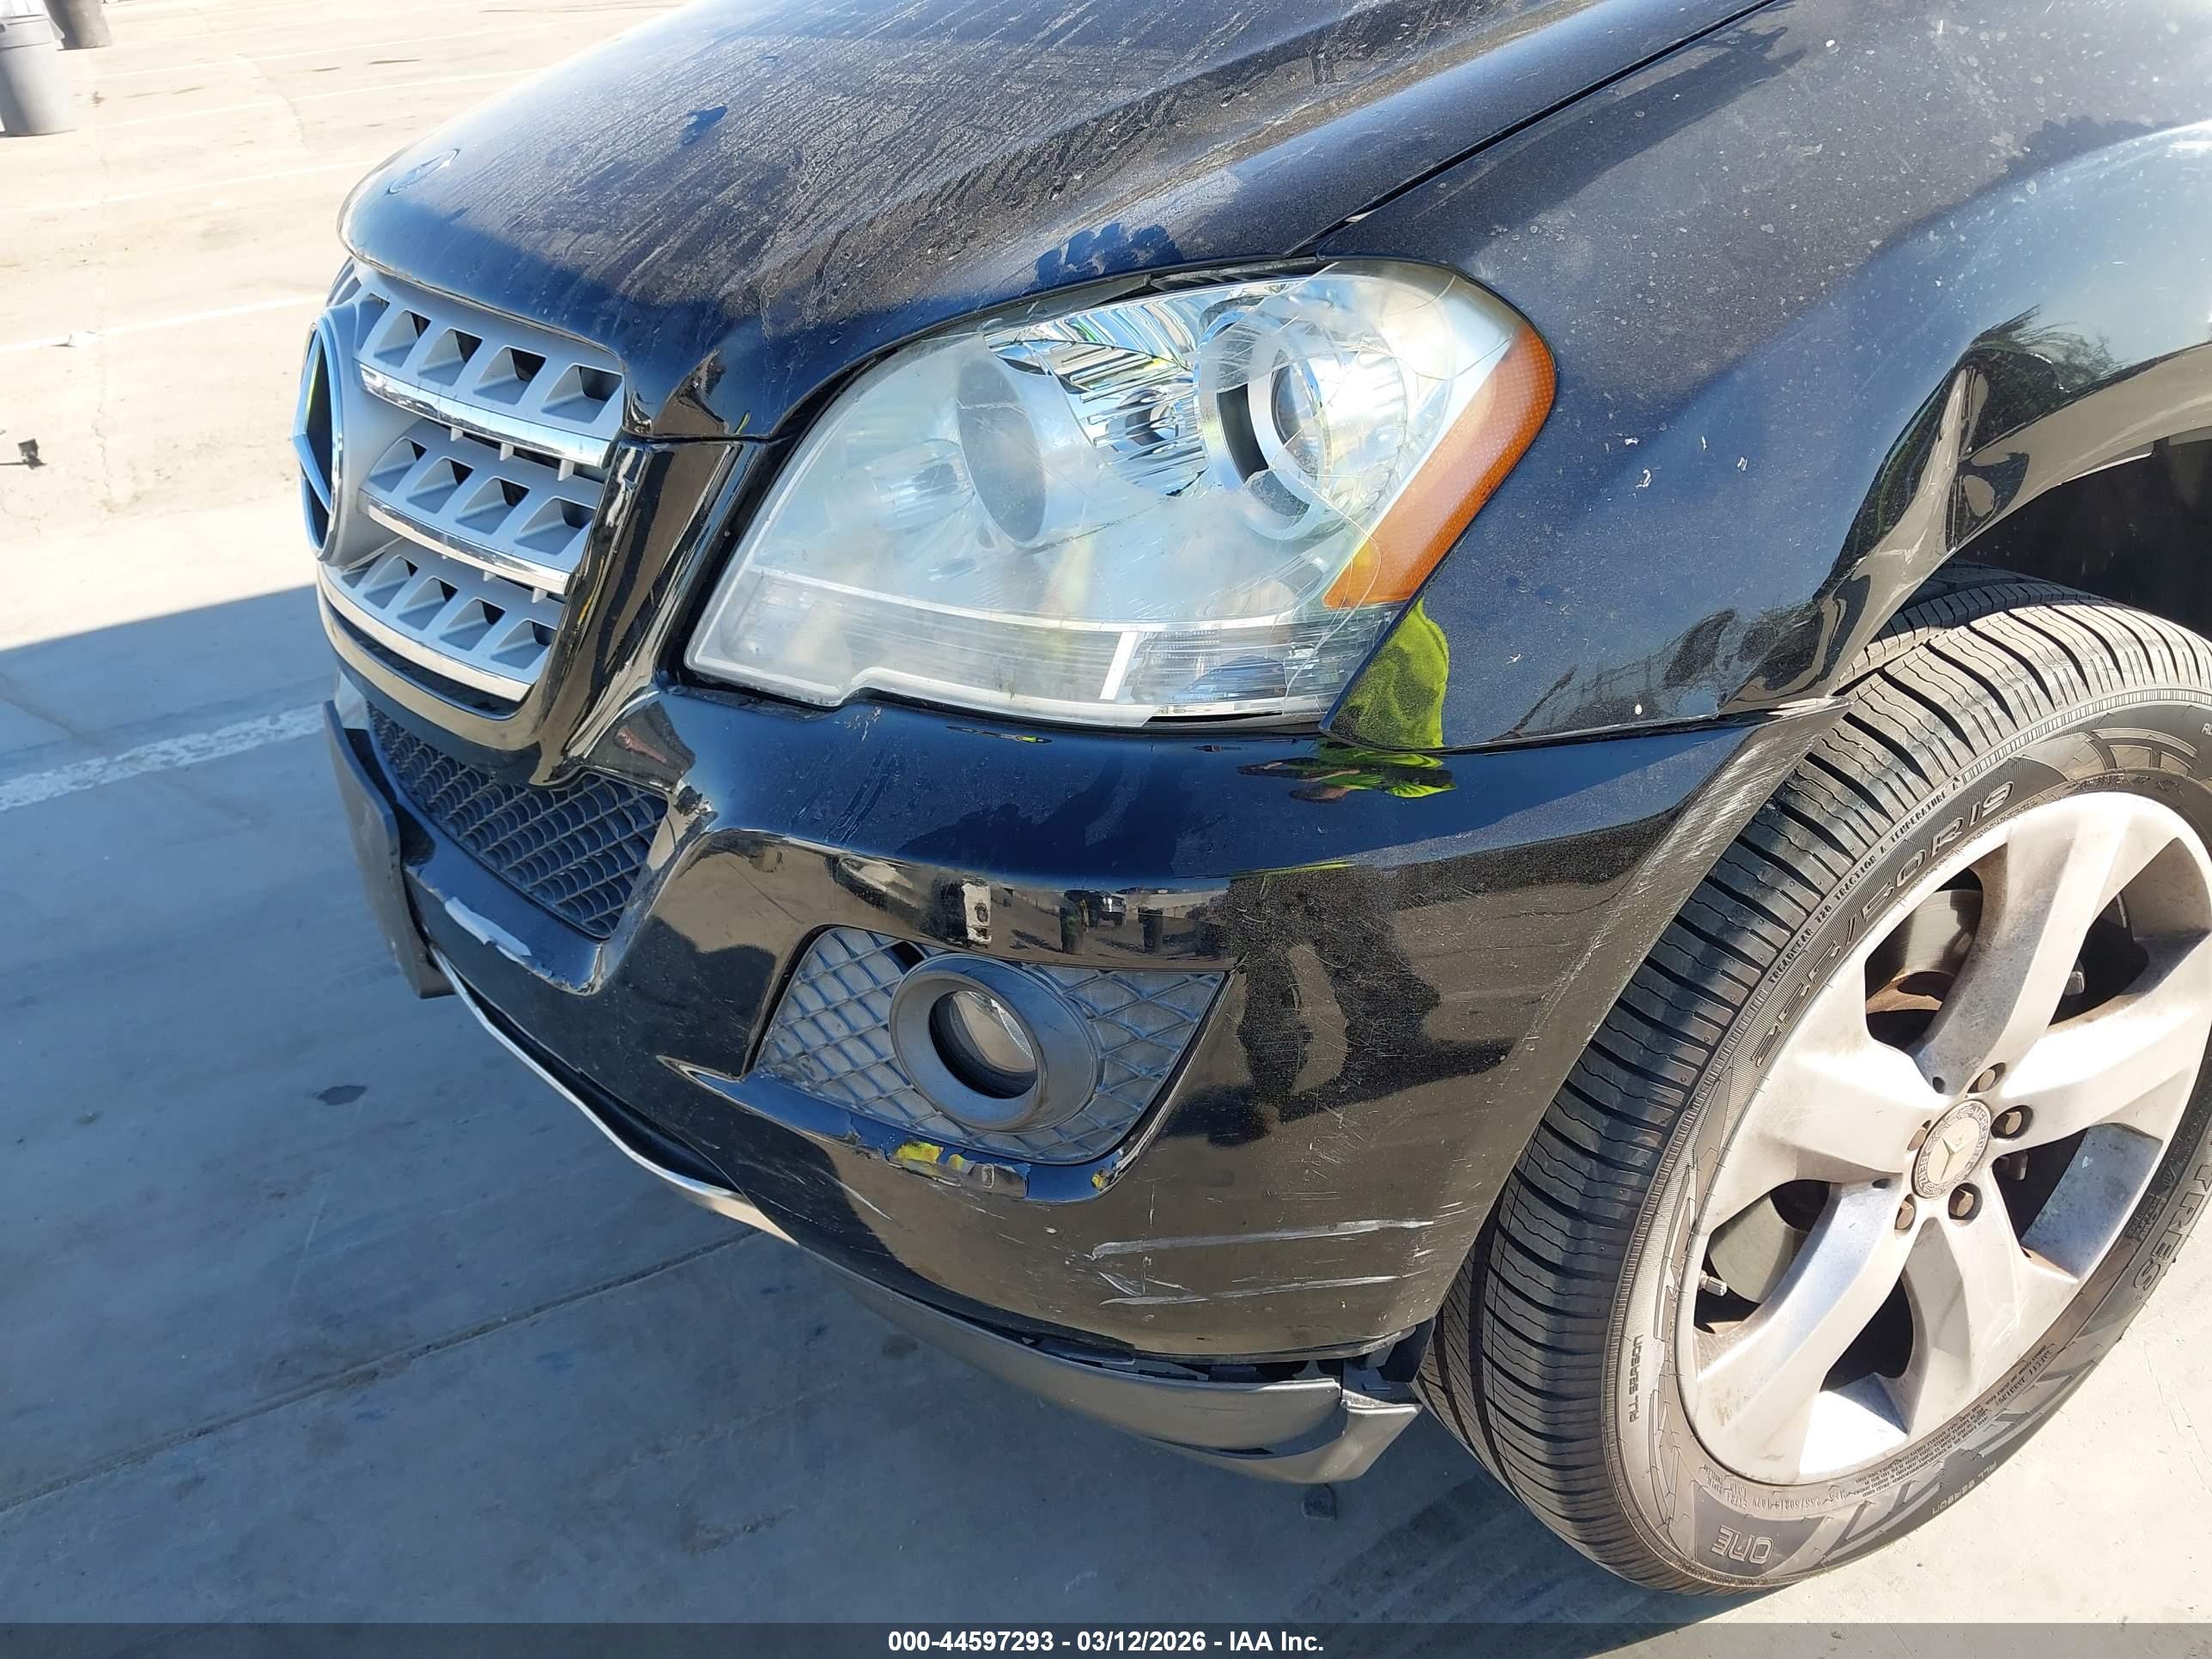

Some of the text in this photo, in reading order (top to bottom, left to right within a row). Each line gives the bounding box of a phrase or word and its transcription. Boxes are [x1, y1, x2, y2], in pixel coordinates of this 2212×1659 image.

[1768, 927, 1814, 985] TREADWEAR
[1834, 854, 1877, 901] TRACTION
[1890, 790, 1948, 843] TEMPERATURE
[1751, 781, 2015, 1067] 255/50R19
[1972, 1106, 1988, 1162] MERCEDES
[1917, 1155, 1929, 1188] BENZ
[1628, 1334, 1644, 1423] ALL SEASON
[1932, 1461, 1997, 1516] ALL SEASON
[1711, 1524, 1774, 1565] ONE
